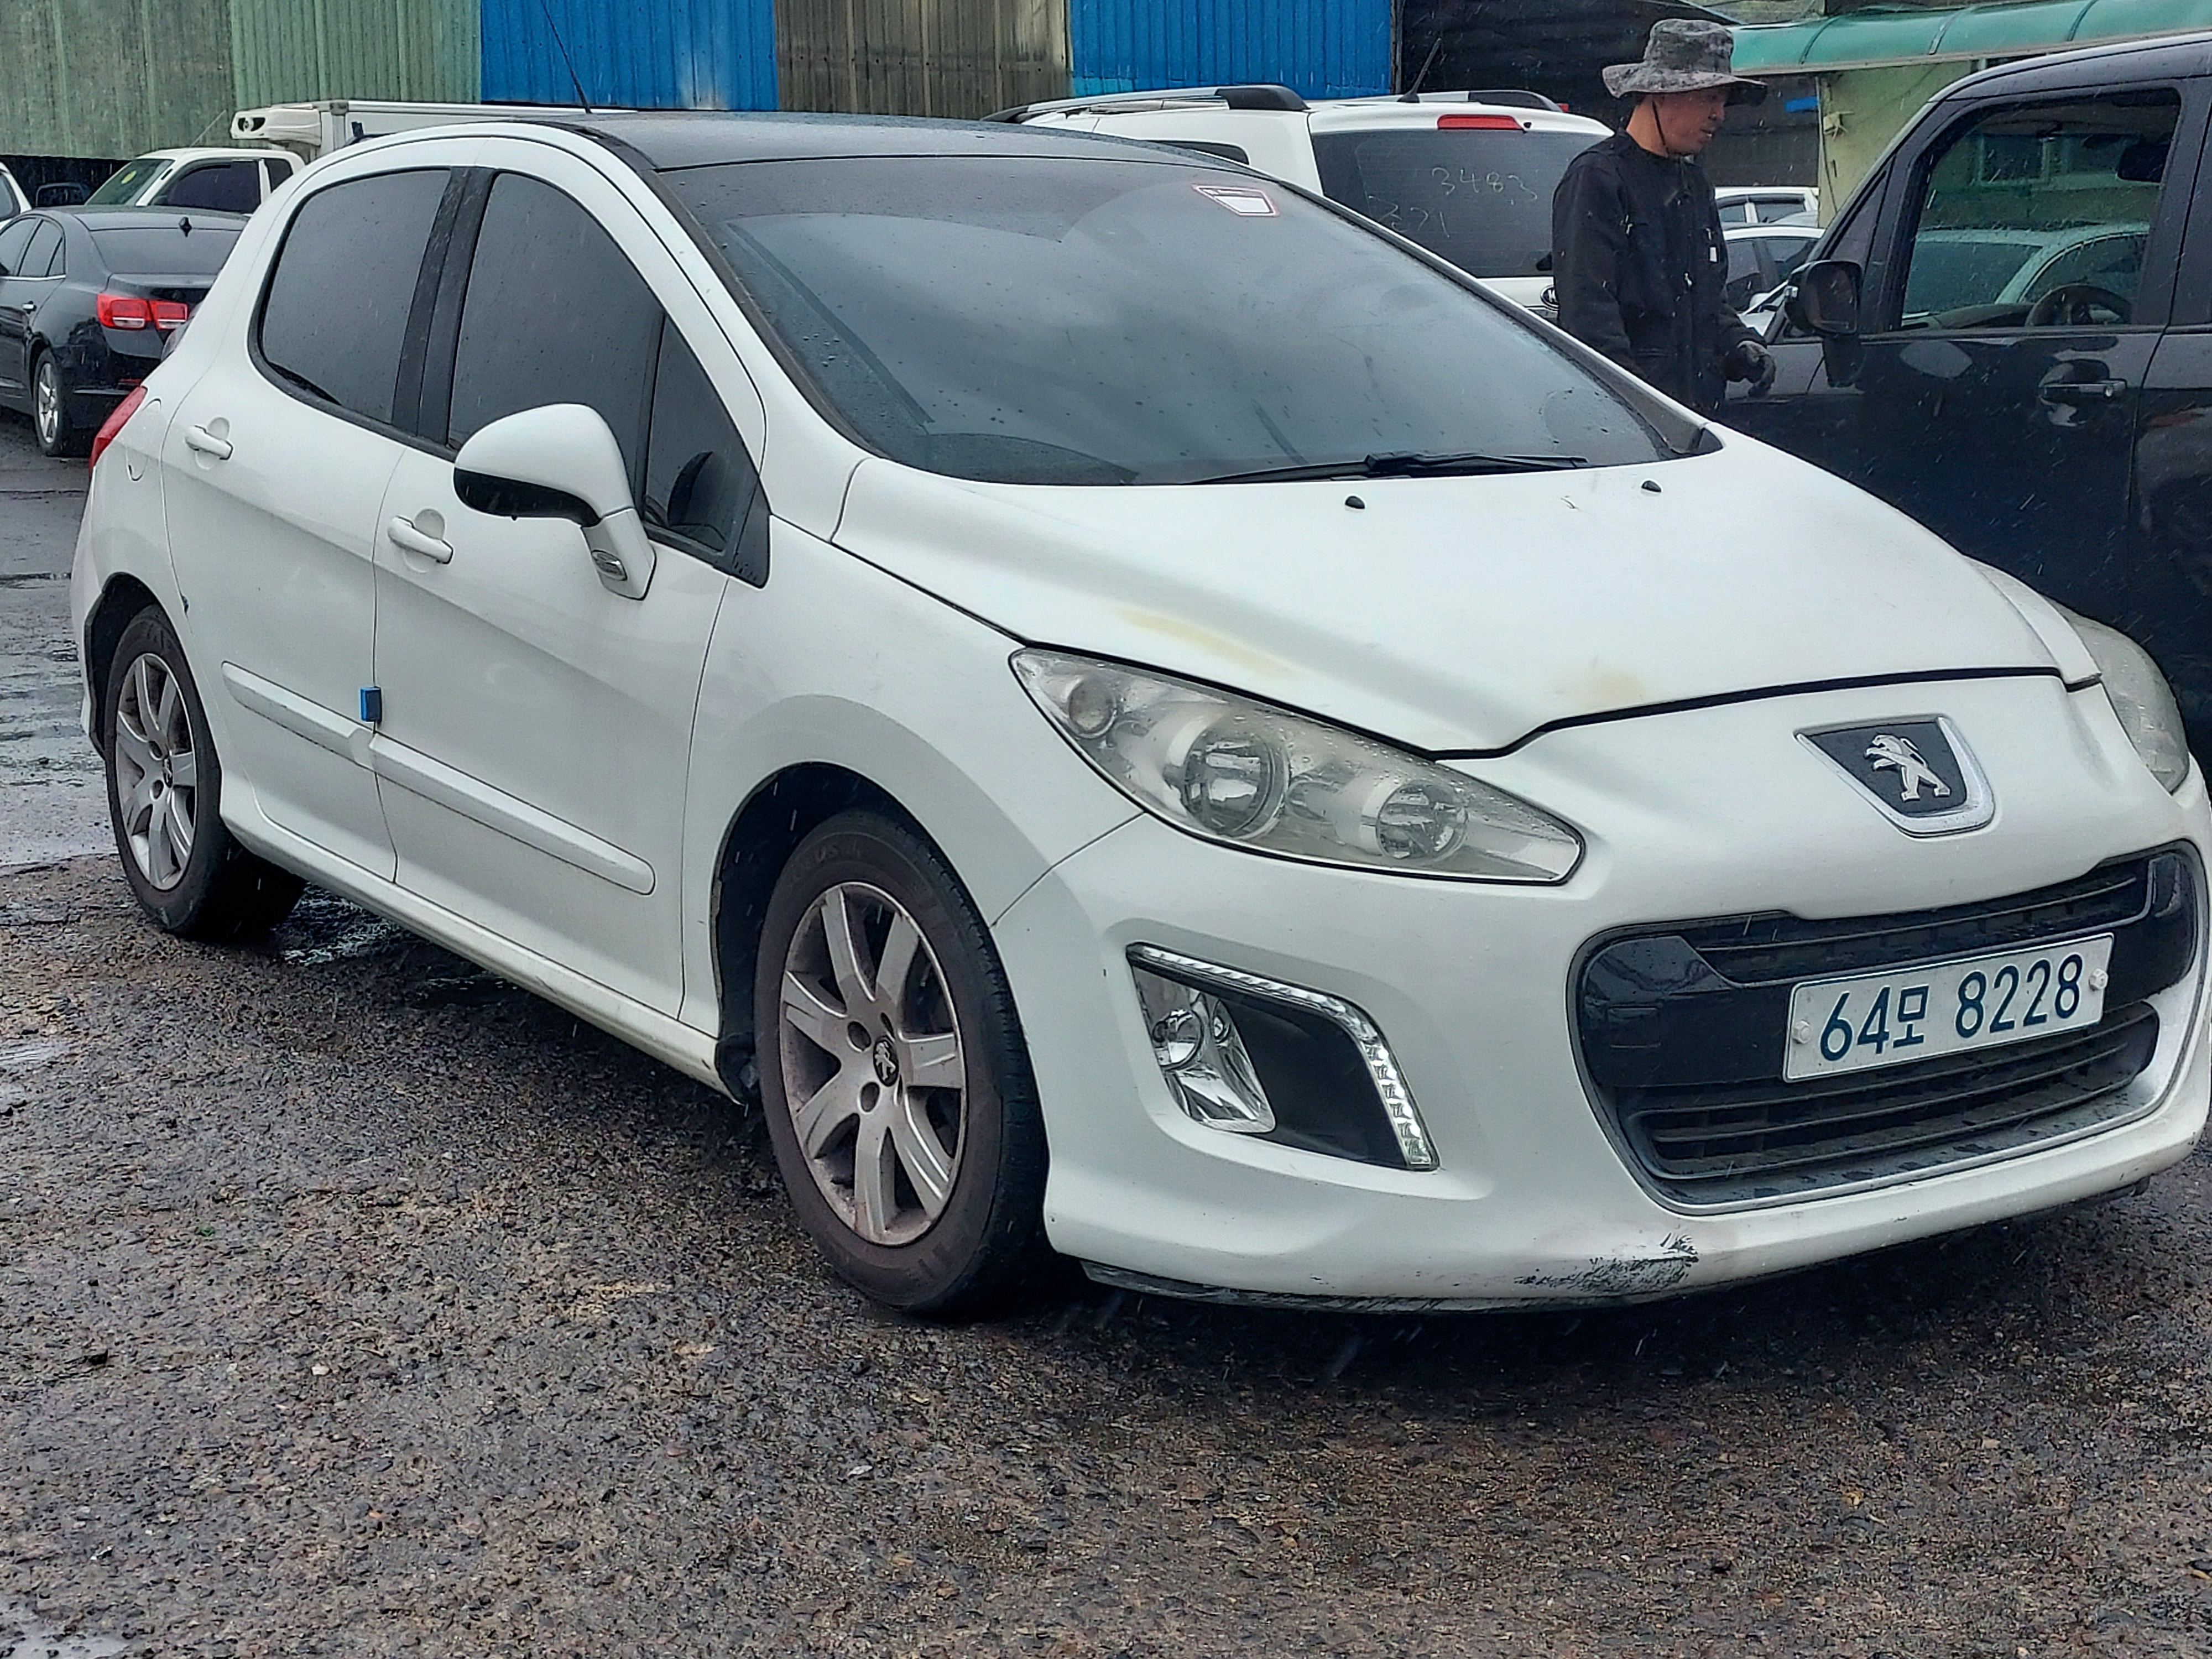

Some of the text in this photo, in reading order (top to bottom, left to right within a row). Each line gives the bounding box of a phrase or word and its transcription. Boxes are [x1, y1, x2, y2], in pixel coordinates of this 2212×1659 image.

[1431, 166, 1538, 201] 3483
[1819, 953, 2084, 1061] 64모 8228
